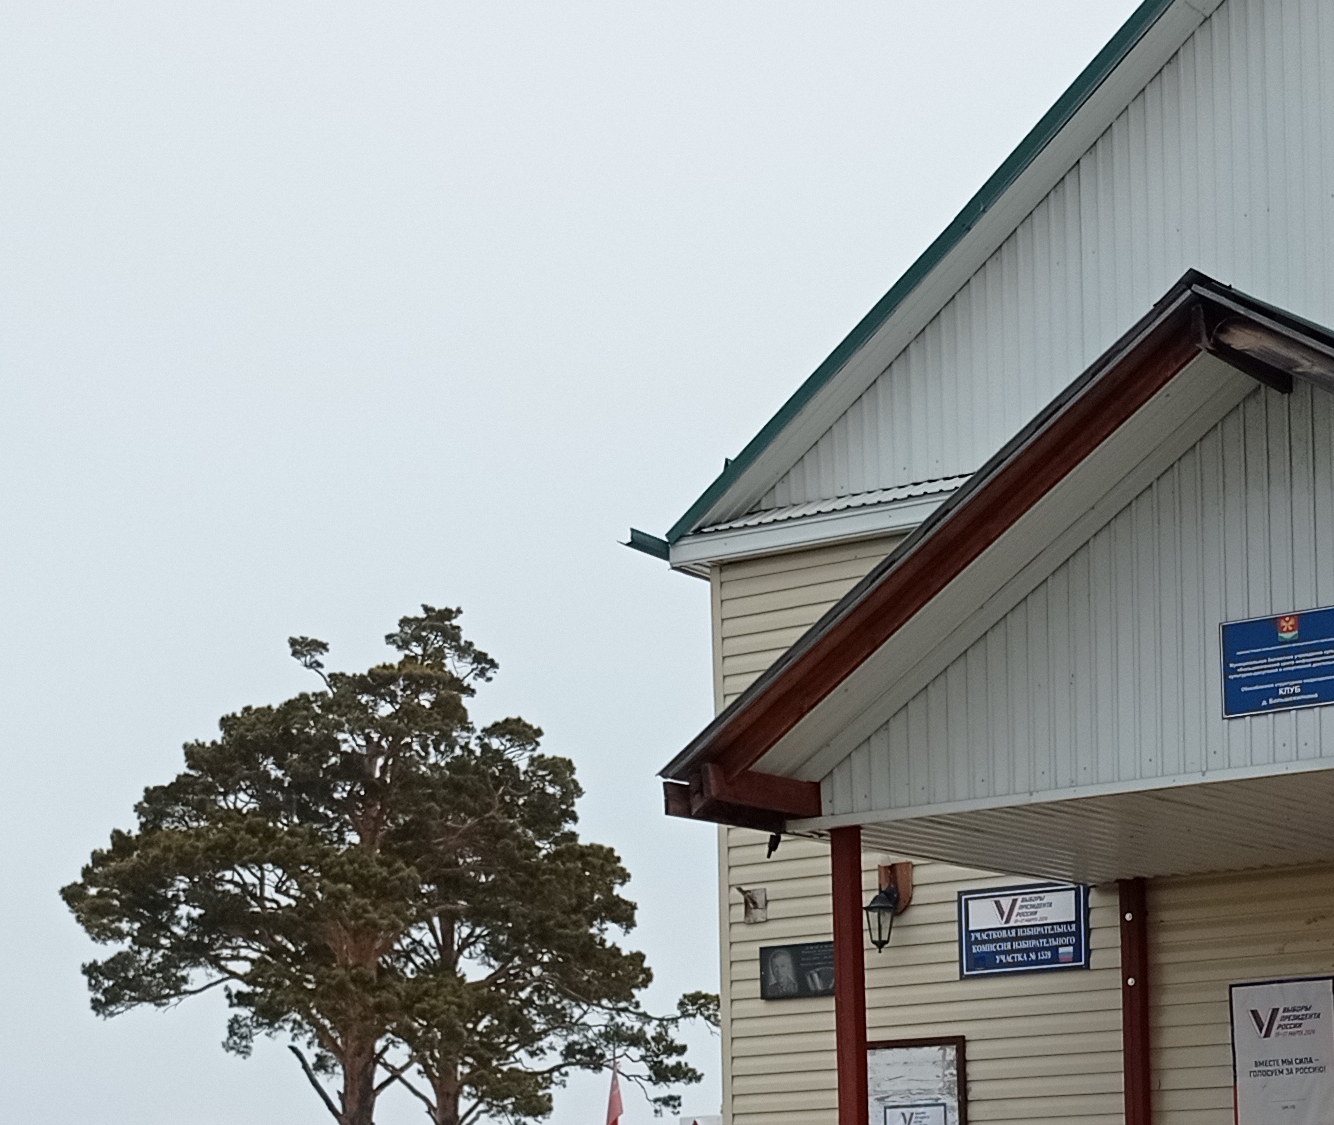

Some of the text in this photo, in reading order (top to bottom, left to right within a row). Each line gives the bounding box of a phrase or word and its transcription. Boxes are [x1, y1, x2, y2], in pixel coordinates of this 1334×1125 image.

[1278, 685, 1301, 695] КЛУБ
[1021, 895, 1045, 903] ВЫБОРЫ
[1018, 902, 1053, 911] ПРЕЗИДЕНТА
[970, 923, 1076, 941] УЧАСТКОВАЯ ИЗБИРАТЕЛЬНАЯ
[972, 936, 1076, 953] КОМИССИЯ ИЗБИРАТЕЛЬНОГО
[995, 953, 1027, 964] УЧАСТКА
[1282, 1005, 1312, 1013] ВЫБОРЫ
[1279, 1012, 1321, 1022] ПРЕЗИДЕНТА
[1276, 1022, 1304, 1030] РОССИИ
[1254, 1059, 1280, 1068] ВМЕСТЕ
[1281, 1058, 1294, 1066] МЫ
[1294, 1056, 1314, 1065] СИЛА
[1249, 1065, 1326, 1078] ГОЛОСУЕМ ЗА РОССИЮ!
